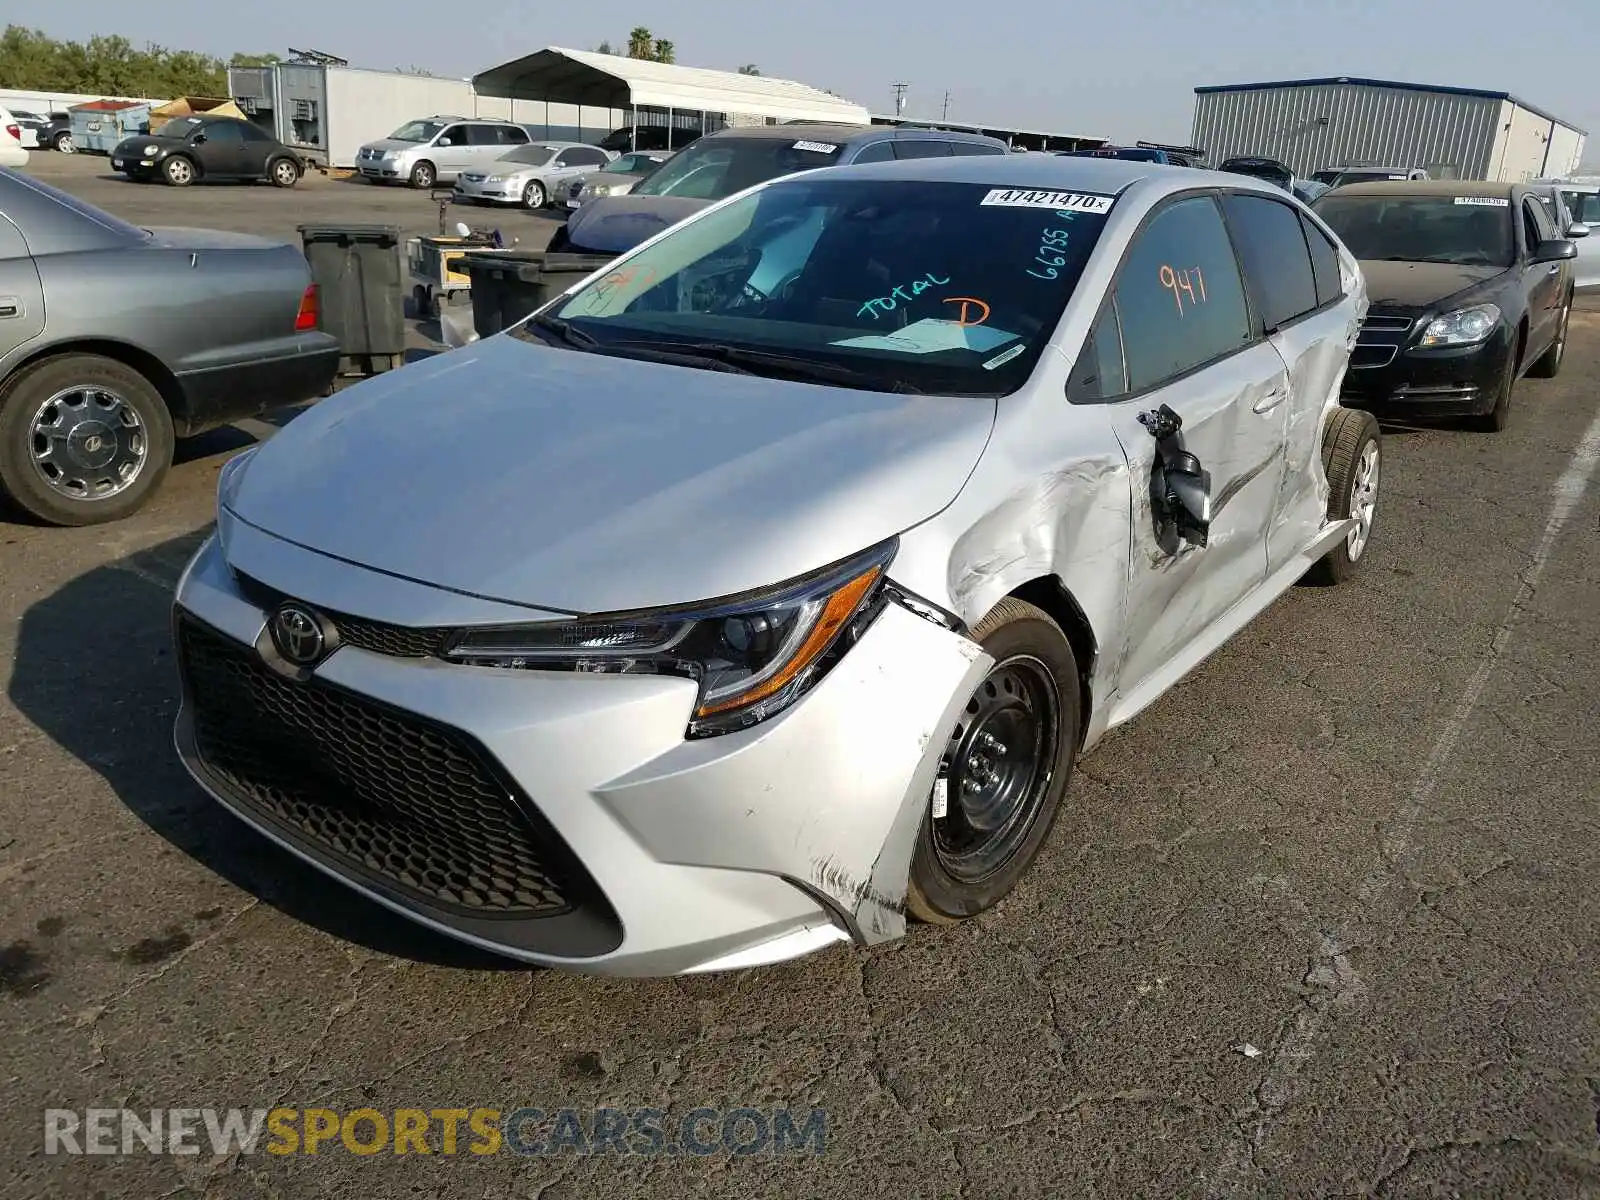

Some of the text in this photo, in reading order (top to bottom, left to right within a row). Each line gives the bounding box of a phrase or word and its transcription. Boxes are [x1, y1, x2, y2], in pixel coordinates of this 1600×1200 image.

[856, 272, 951, 320] TOTAL
[942, 297, 991, 328] D
[1160, 265, 1206, 320] 947
